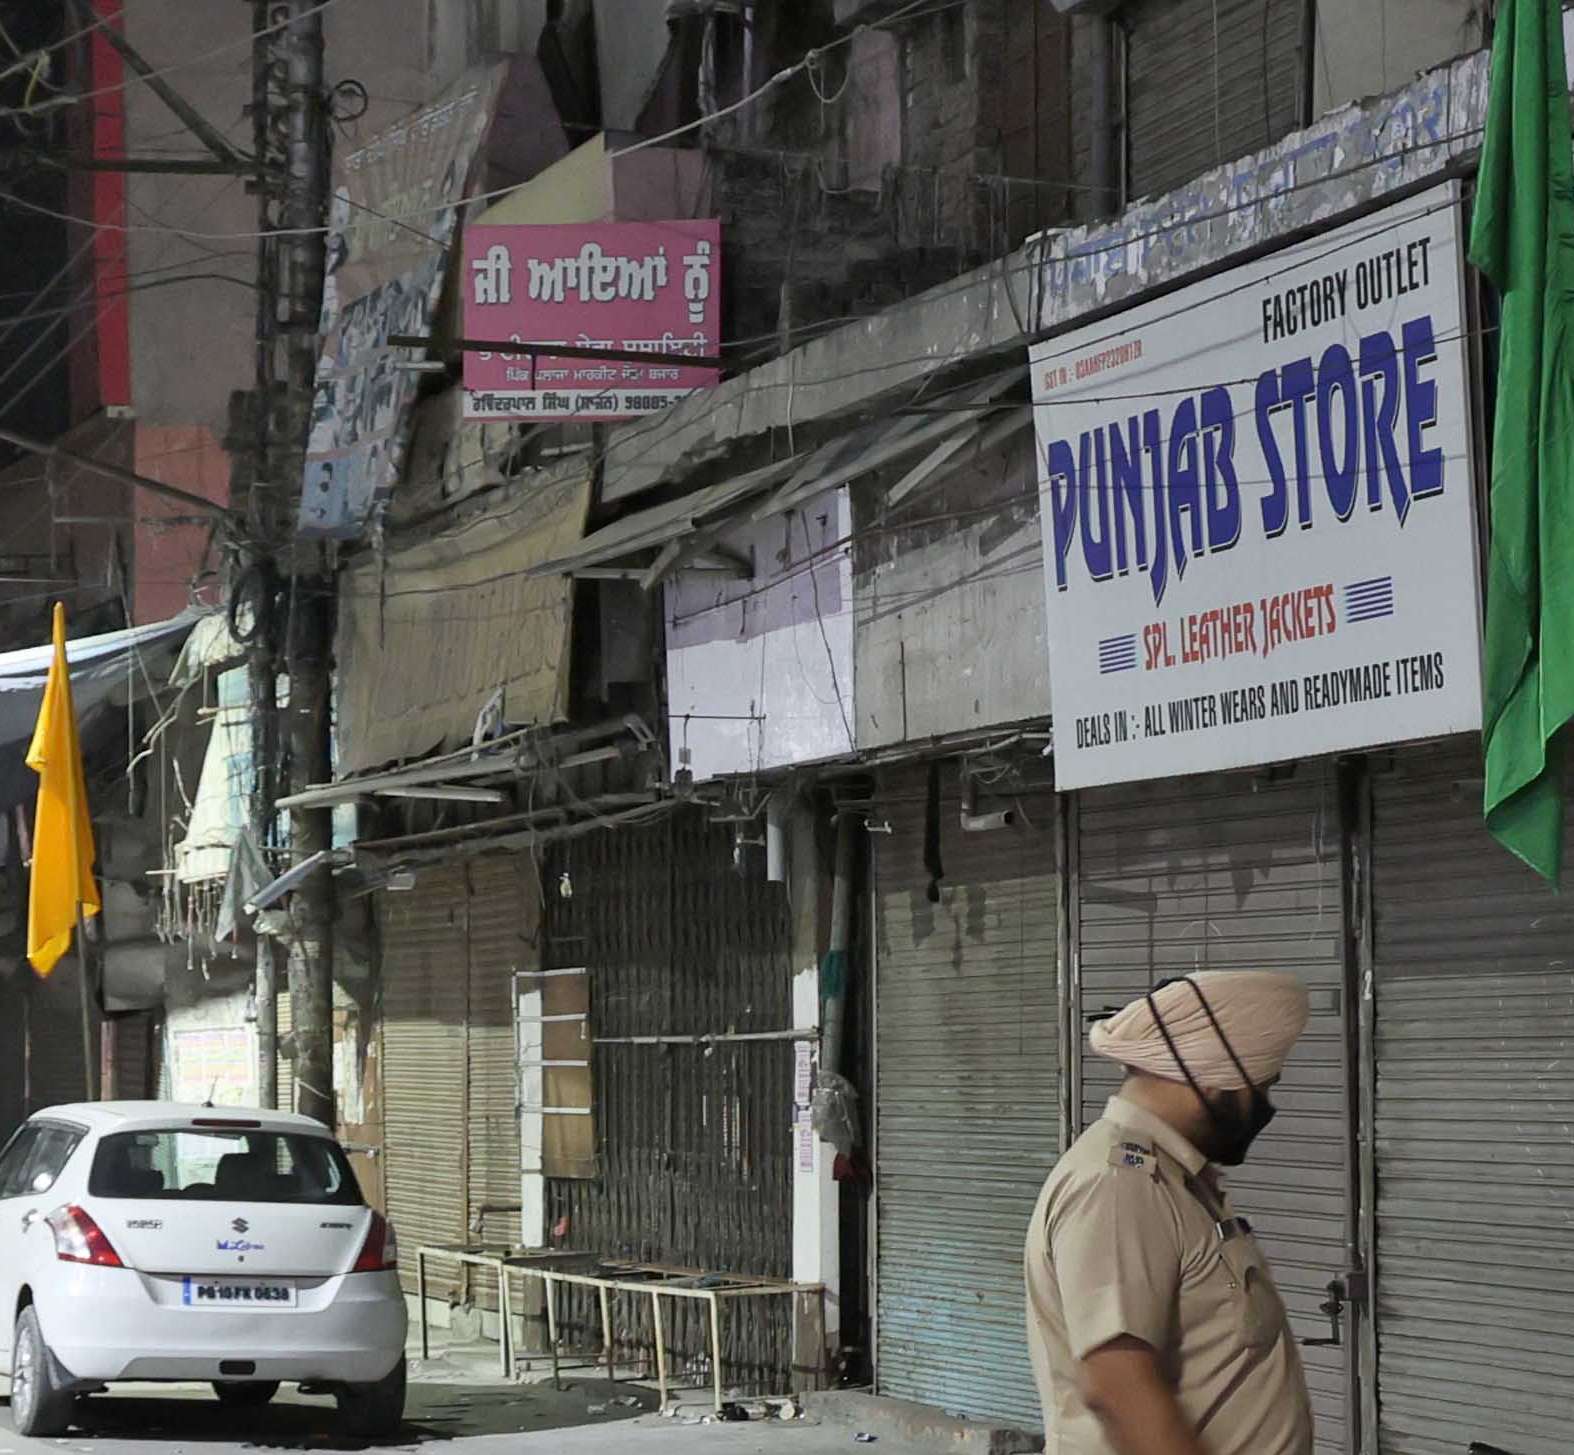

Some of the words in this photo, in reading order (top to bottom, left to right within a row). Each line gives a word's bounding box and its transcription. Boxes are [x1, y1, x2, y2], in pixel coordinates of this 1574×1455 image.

[472, 245, 512, 304] ਜੀ
[1263, 269, 1348, 343] FACTORY
[1356, 237, 1431, 310] OUTLET
[1048, 385, 1243, 608] PUNJAB
[1255, 314, 1444, 540] STORE
[1143, 621, 1176, 670] SPL.
[1180, 602, 1257, 664] LEATHER
[1260, 584, 1337, 659] JACKETS
[1076, 717, 1111, 750] DEALS
[1115, 709, 1128, 743] IN
[1144, 705, 1167, 739] ALL
[1168, 694, 1217, 735] WINTER
[1220, 684, 1266, 726] WEARS
[1270, 678, 1300, 718] AND
[1304, 661, 1392, 712] READYMADE
[1395, 652, 1444, 697] ITEMS
